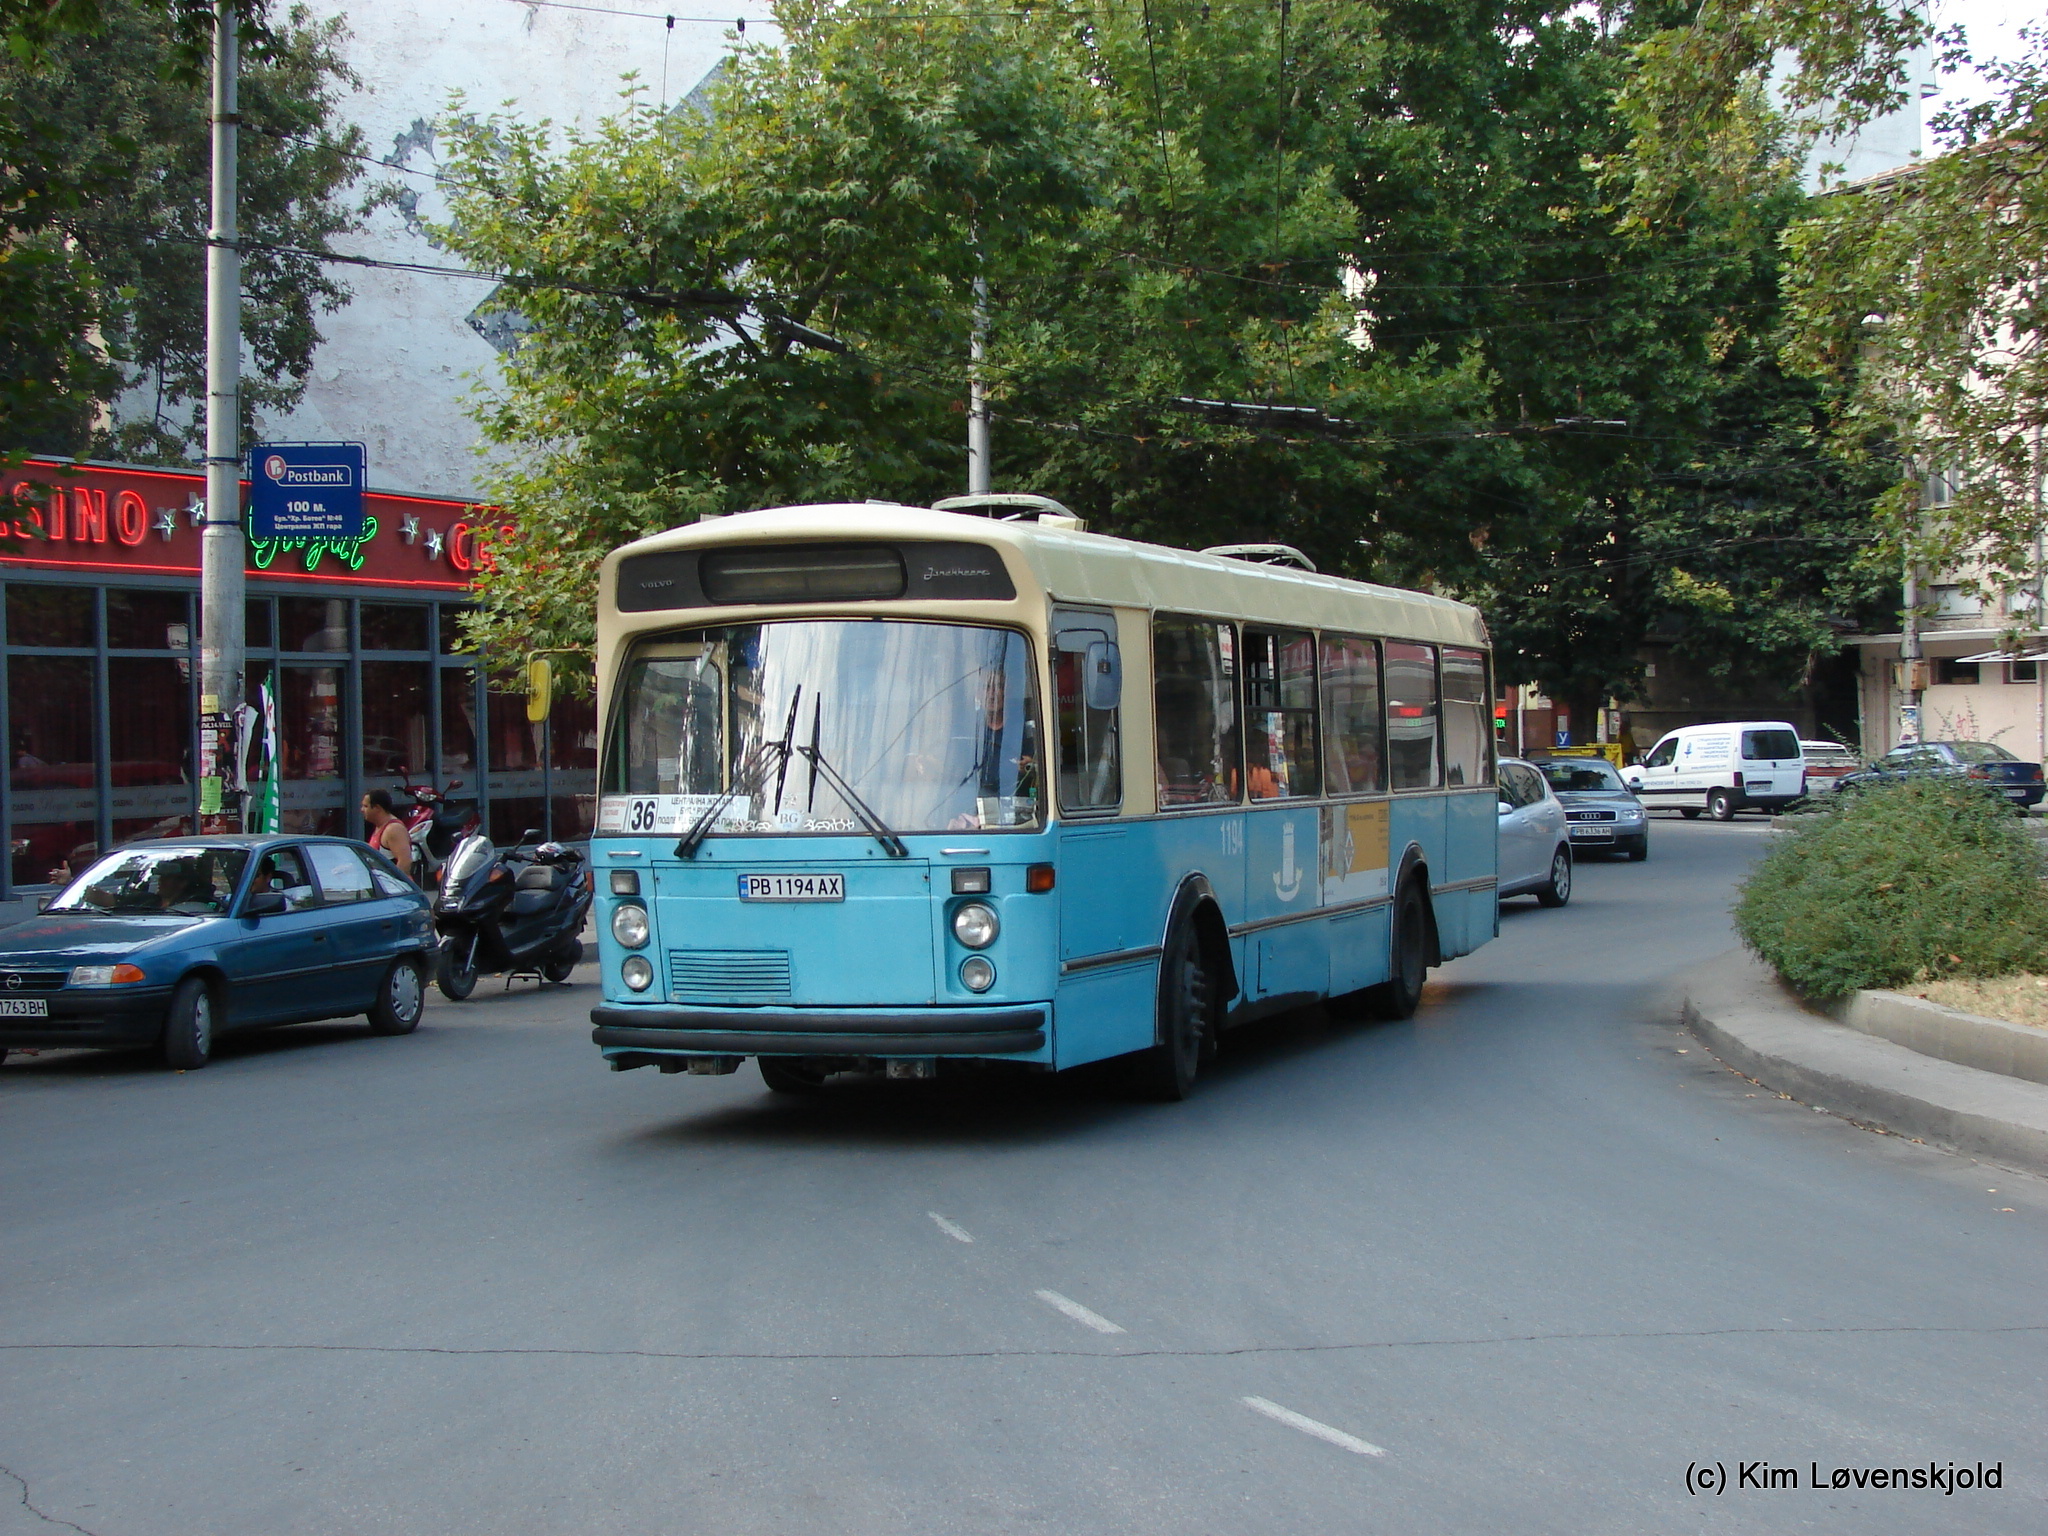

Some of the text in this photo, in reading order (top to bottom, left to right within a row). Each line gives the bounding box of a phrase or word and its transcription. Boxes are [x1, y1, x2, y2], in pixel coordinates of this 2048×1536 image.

[288, 470, 344, 482] Postbank
[287, 501, 310, 512] 100
[0, 482, 149, 547] SINO
[640, 579, 673, 589] VOLVO
[631, 800, 656, 831] 36
[780, 813, 799, 824] BG
[1220, 820, 1243, 856] 1194
[750, 878, 771, 895] PB
[776, 878, 814, 895] 1194
[818, 878, 839, 895] AX
[29, 1001, 46, 1014] BH
